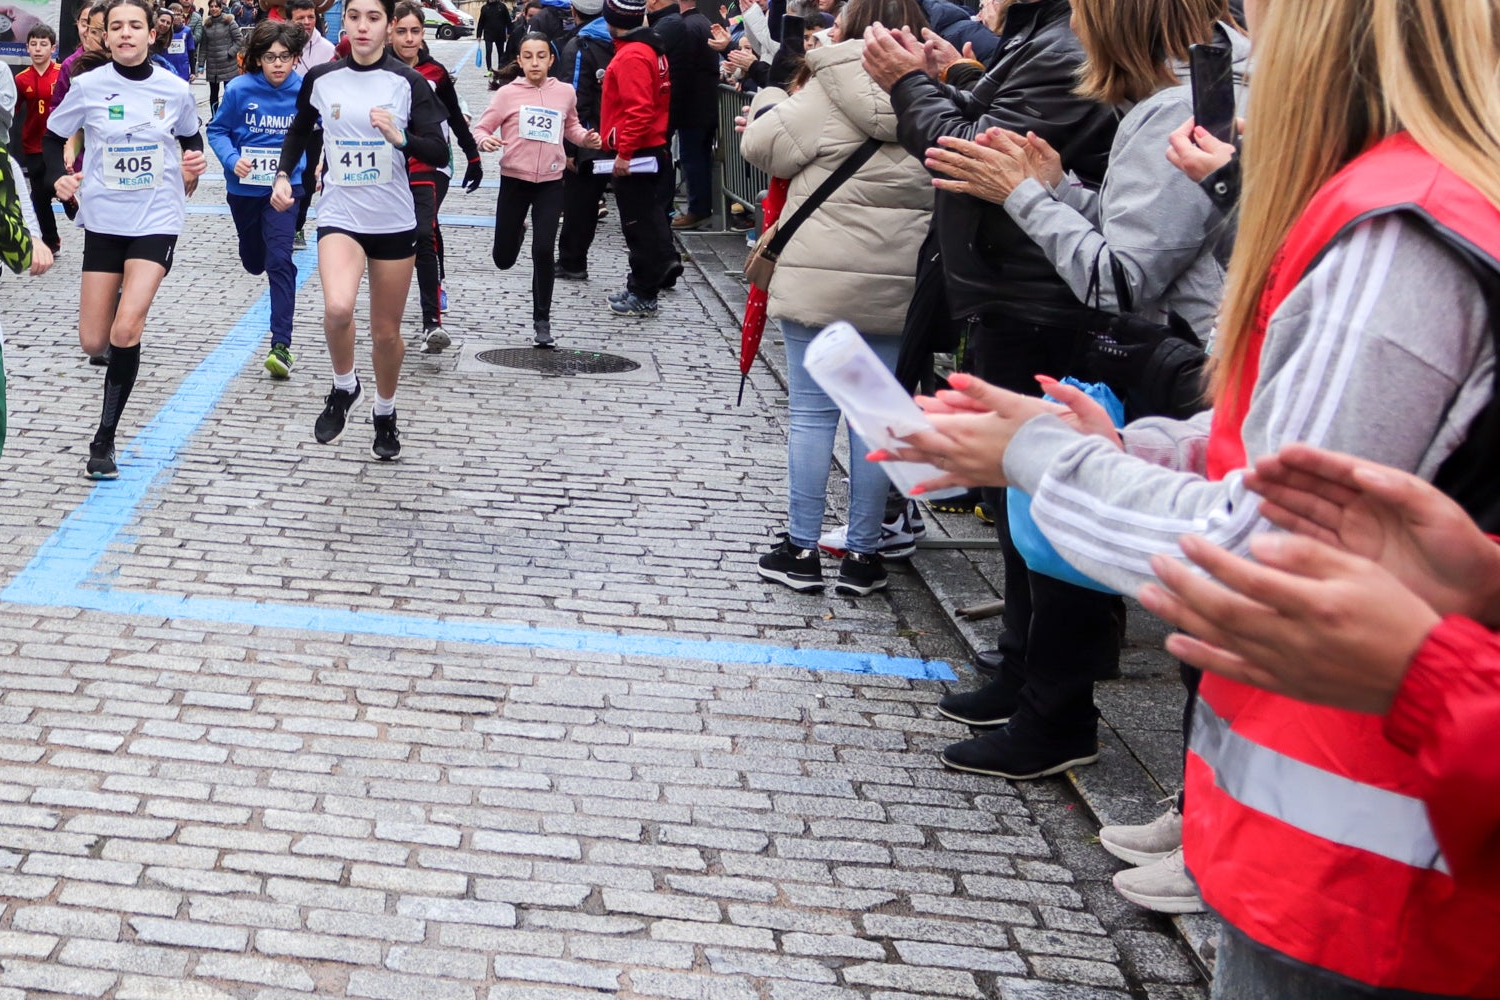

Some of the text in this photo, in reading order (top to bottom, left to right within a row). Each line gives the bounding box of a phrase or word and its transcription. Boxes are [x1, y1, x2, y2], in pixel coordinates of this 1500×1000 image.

[38, 99, 45, 114] 6
[245, 112, 257, 126] LA
[527, 115, 552, 129] 423
[114, 156, 152, 173] 405
[340, 151, 376, 168] 411
[119, 177, 150, 186] HESAN
[344, 172, 377, 181] HESAN
